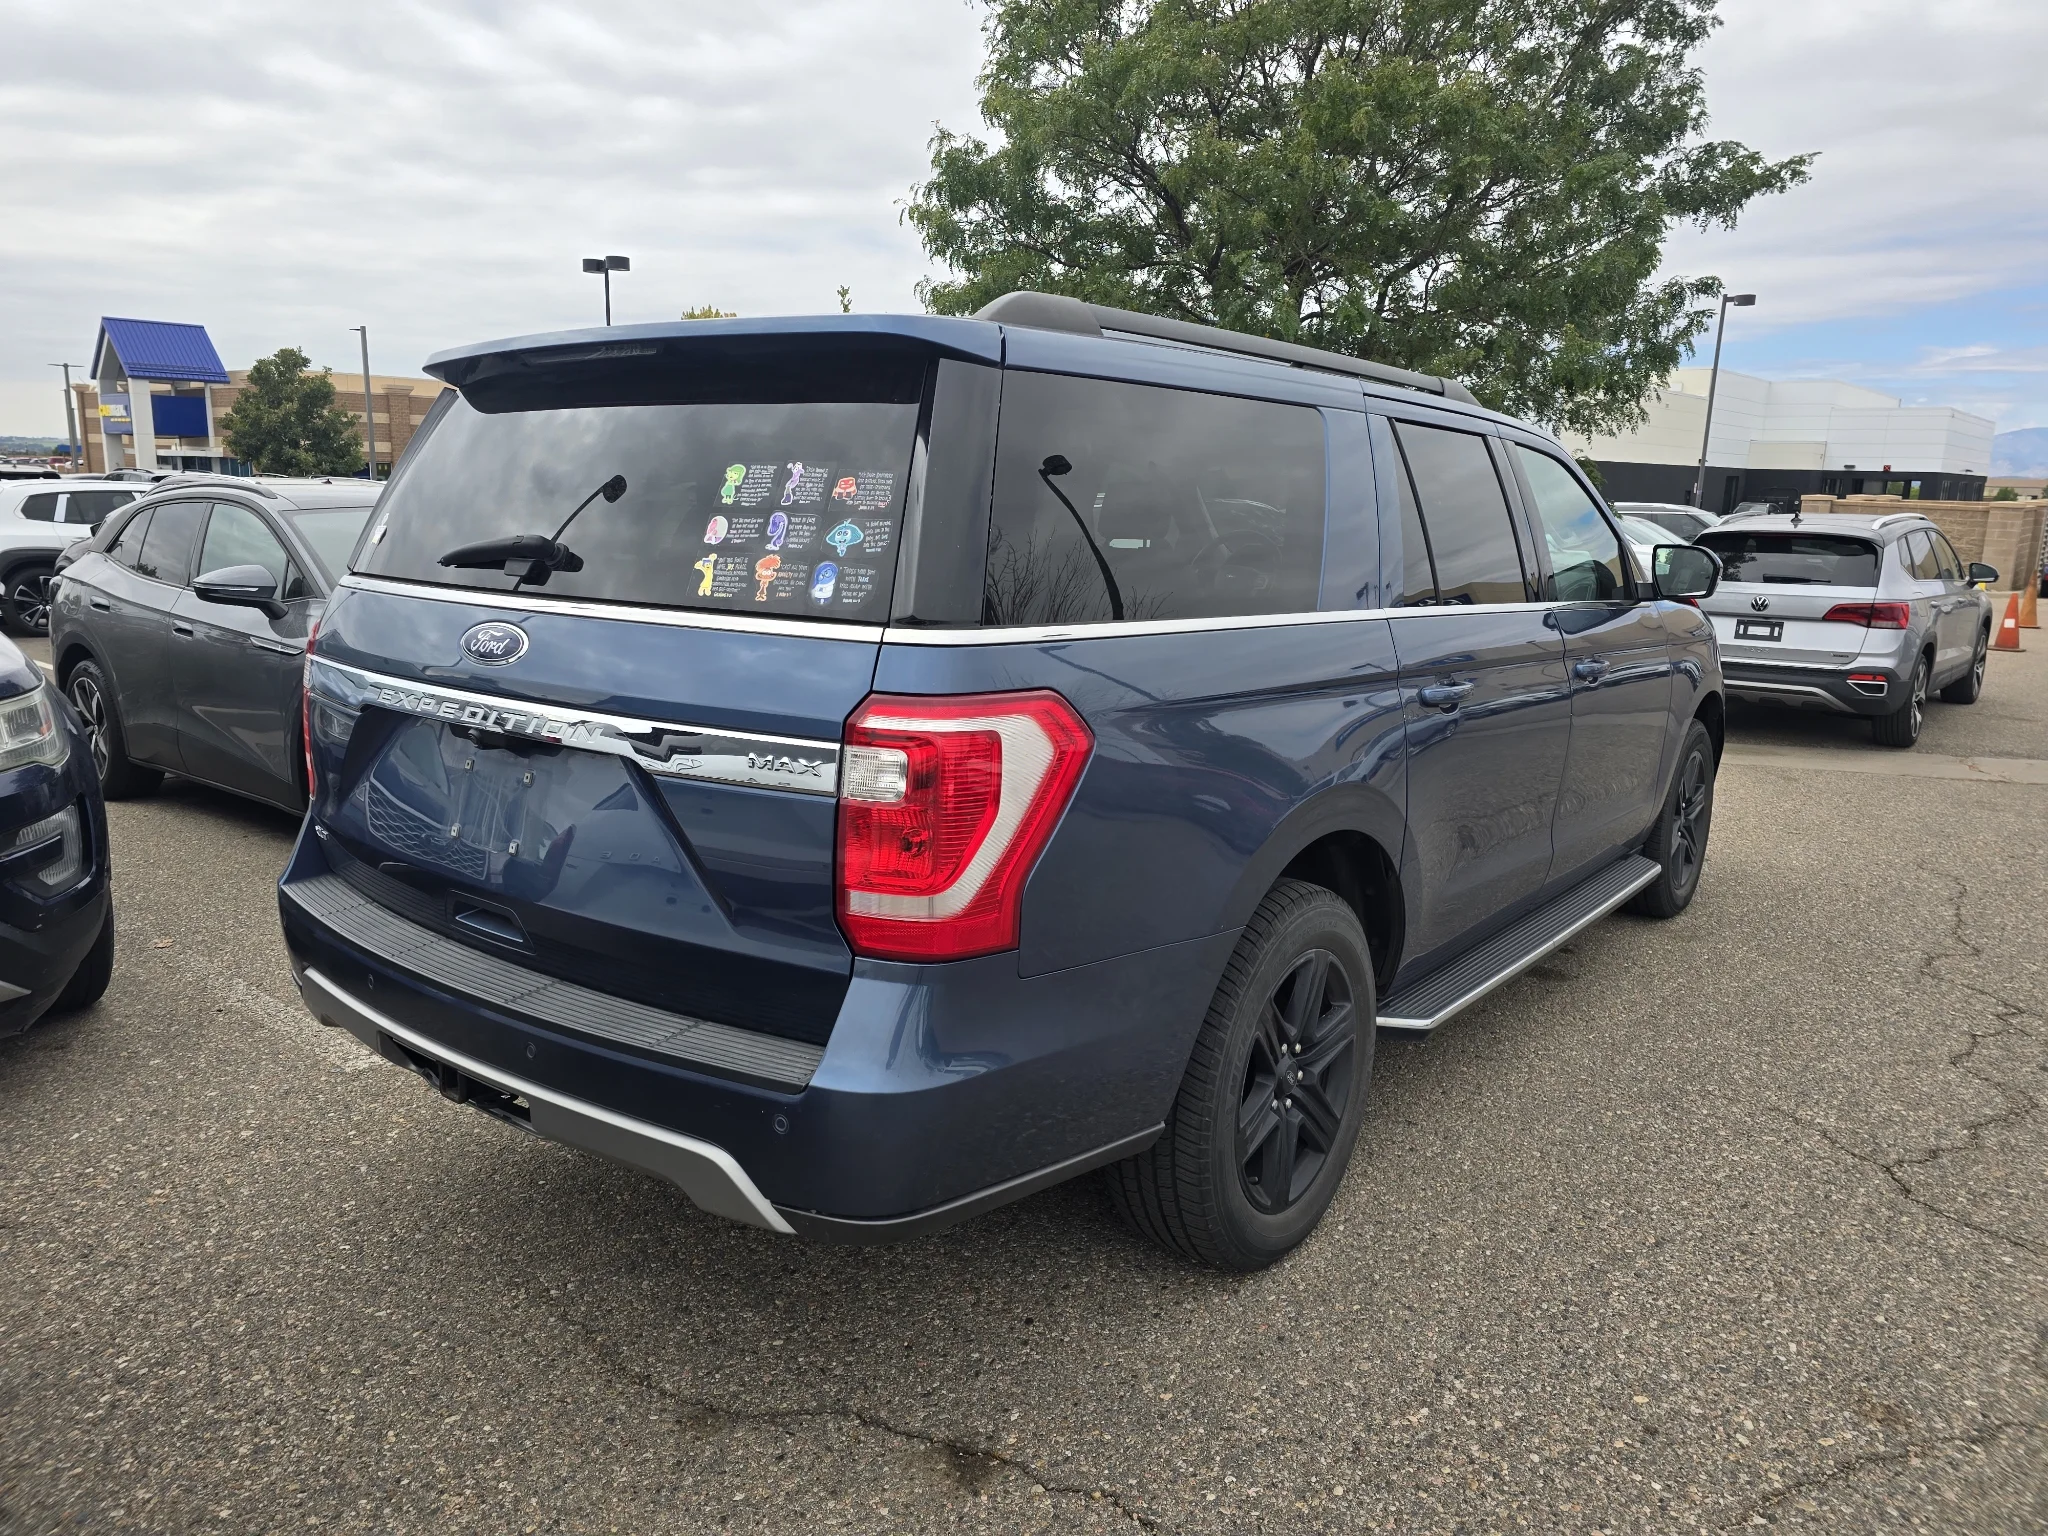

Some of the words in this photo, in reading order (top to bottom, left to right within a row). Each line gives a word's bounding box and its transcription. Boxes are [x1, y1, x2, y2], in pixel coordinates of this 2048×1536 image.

[471, 629, 513, 655] Ford
[377, 688, 604, 743] EXPEDITION
[748, 752, 824, 777] MAX
